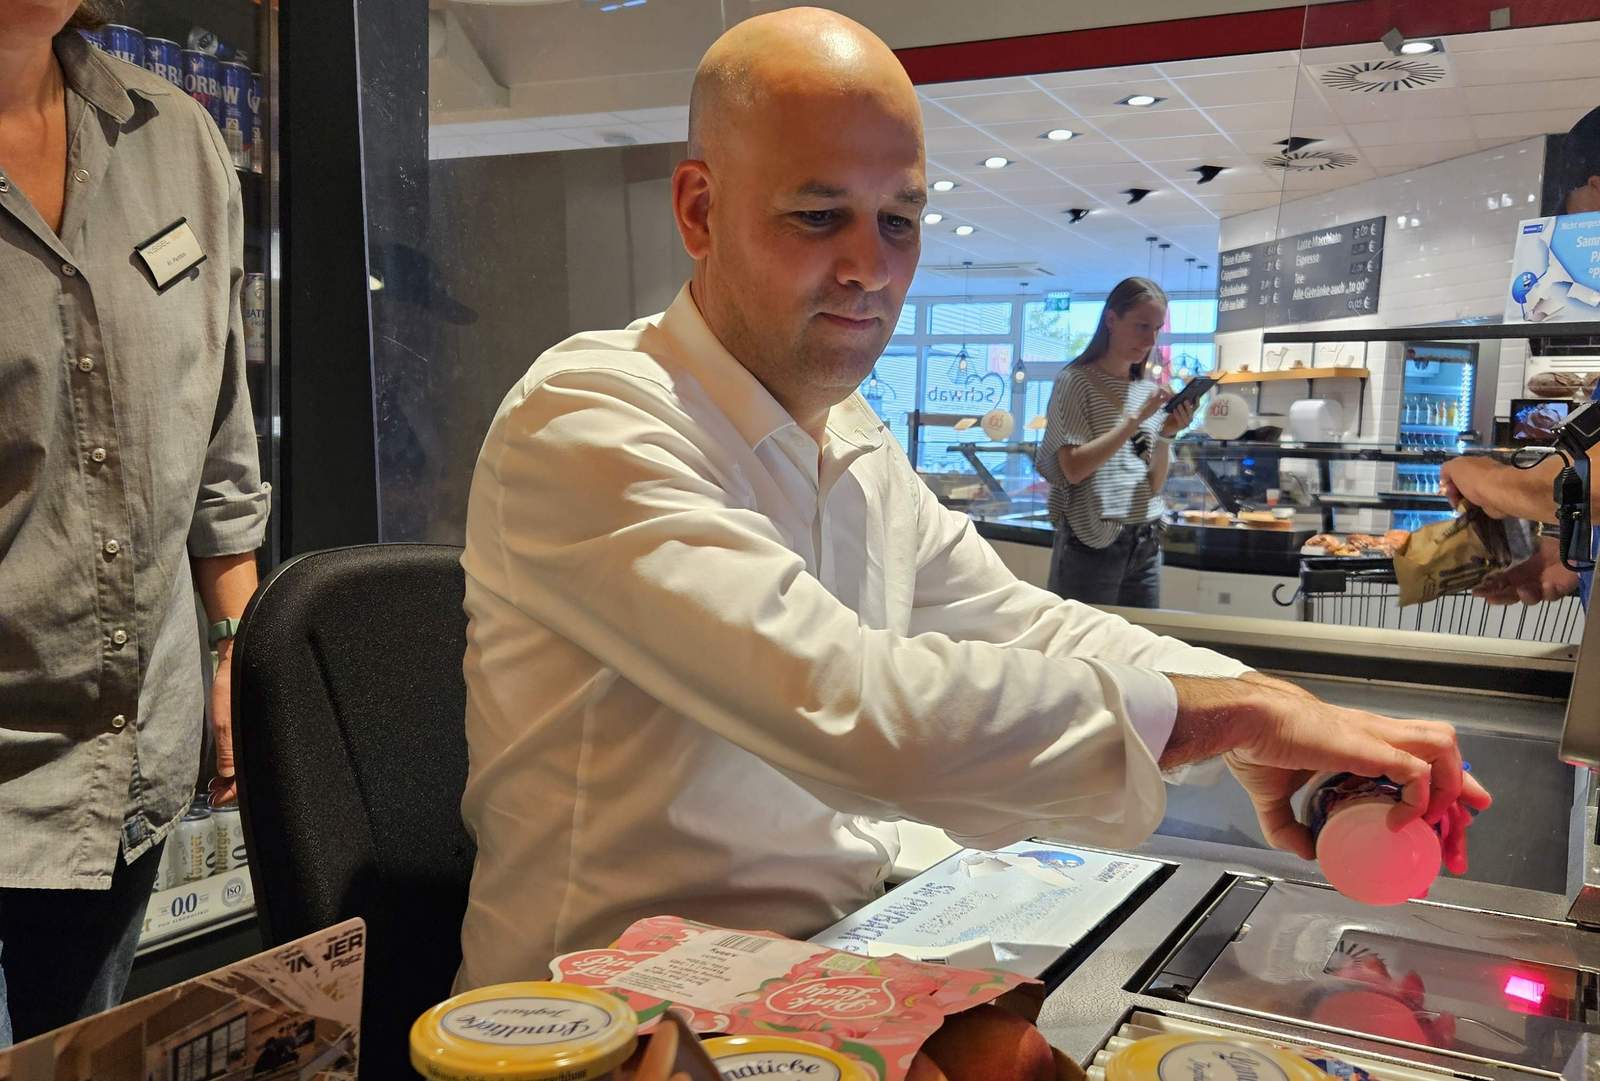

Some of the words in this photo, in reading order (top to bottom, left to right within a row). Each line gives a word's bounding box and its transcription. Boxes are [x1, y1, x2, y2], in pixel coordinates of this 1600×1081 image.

[226, 884, 241, 898] ISO
[171, 892, 198, 918] 0.0
[456, 1014, 596, 1038] Landliebe
